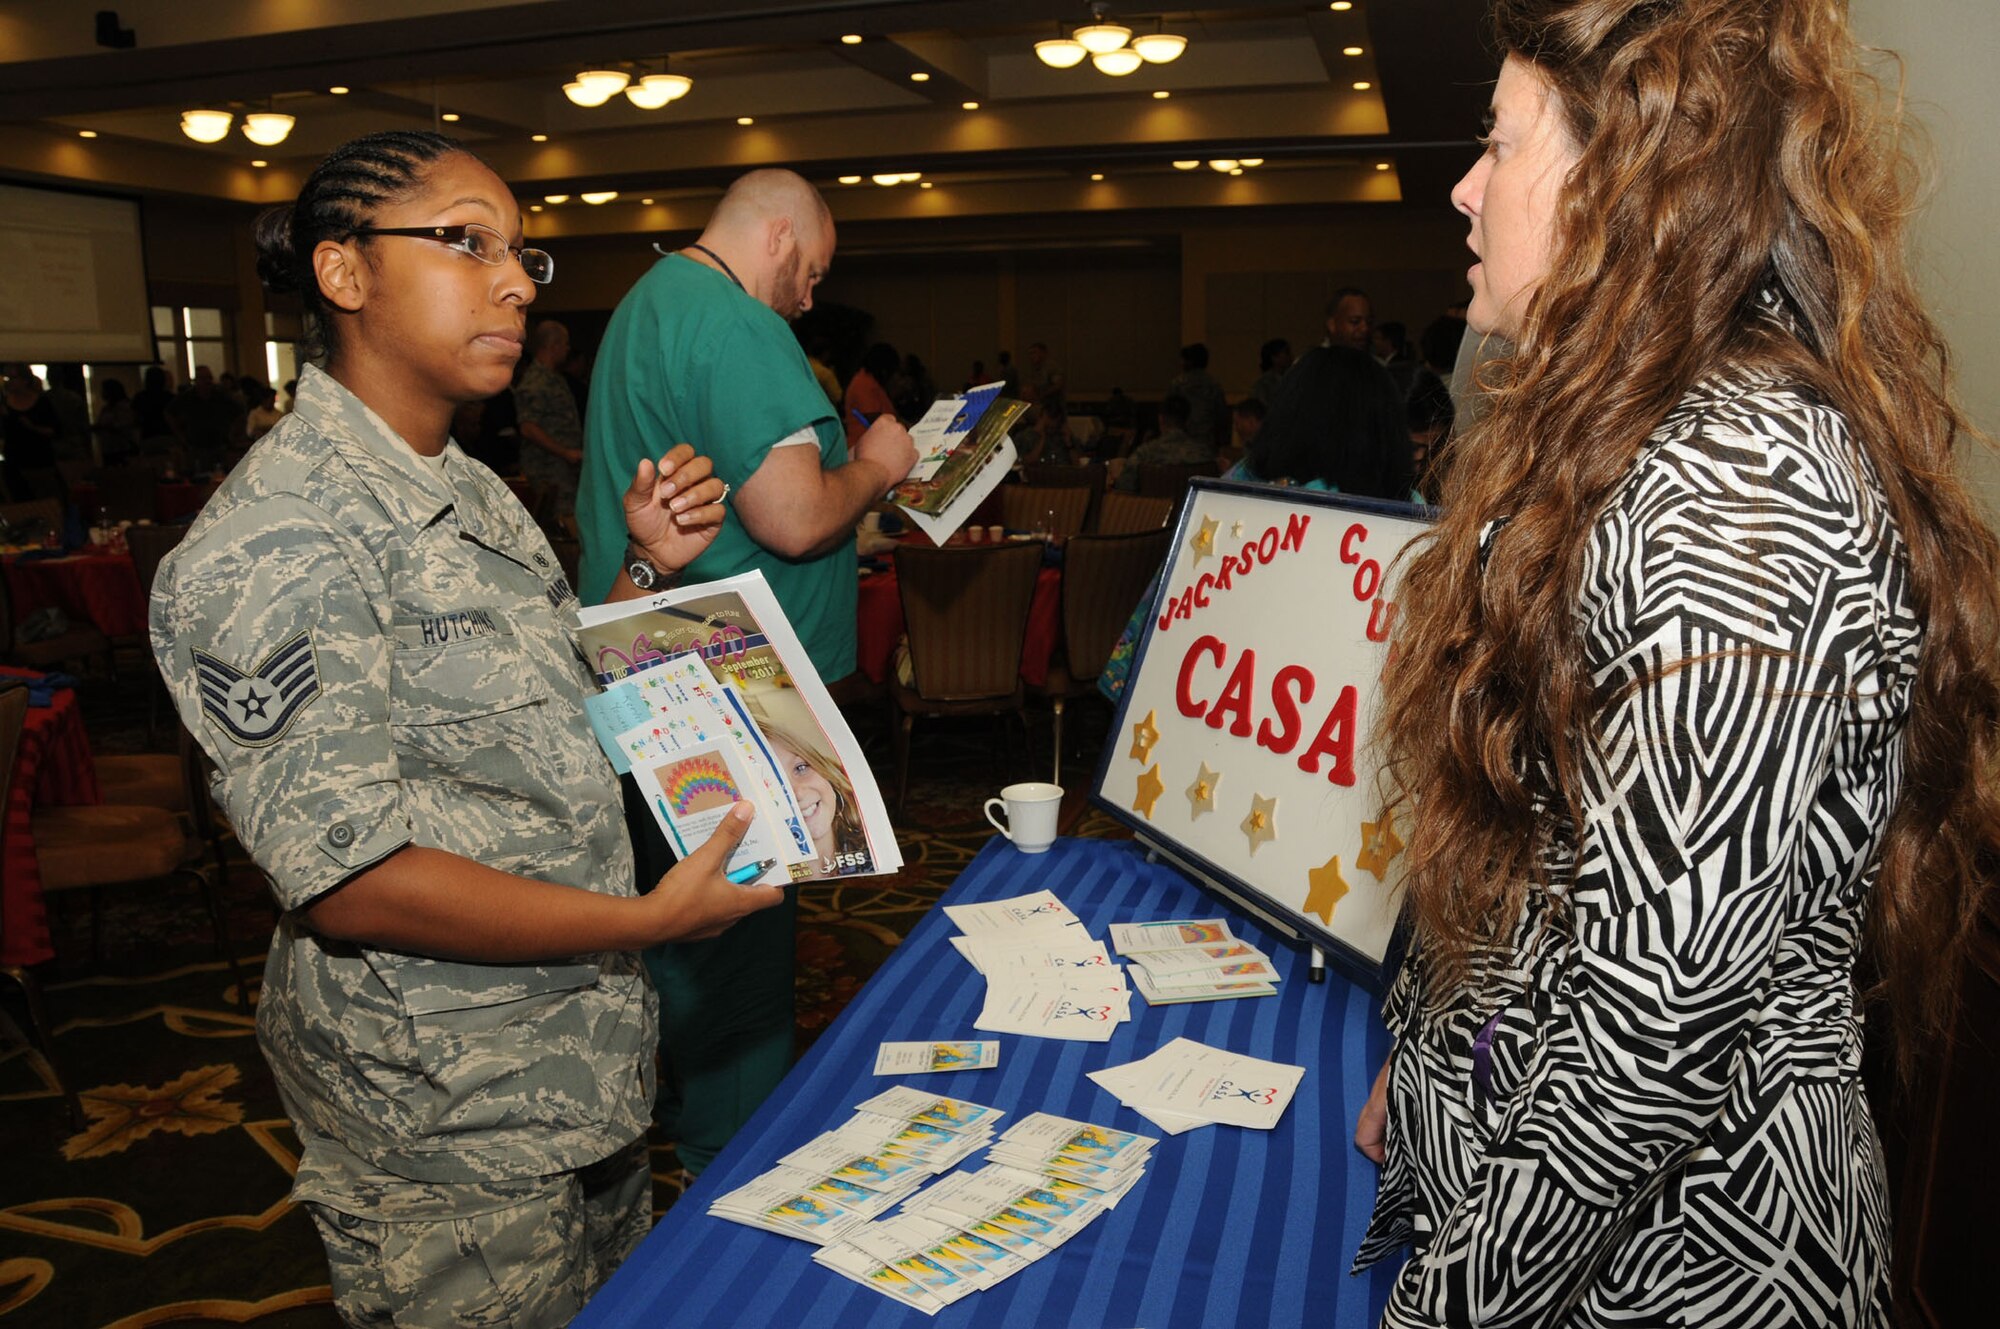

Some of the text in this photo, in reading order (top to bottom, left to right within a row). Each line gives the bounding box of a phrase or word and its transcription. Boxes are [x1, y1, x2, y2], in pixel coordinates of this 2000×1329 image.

[1158, 513, 1312, 631] JACKSON
[421, 610, 496, 644] HUTCHINS
[722, 655, 770, 674] September
[752, 666, 776, 680] 2011
[1176, 635, 1358, 787] CASA
[836, 851, 866, 868] FSS
[1053, 1001, 1072, 1020] CASA
[1211, 1080, 1234, 1100] CASA
